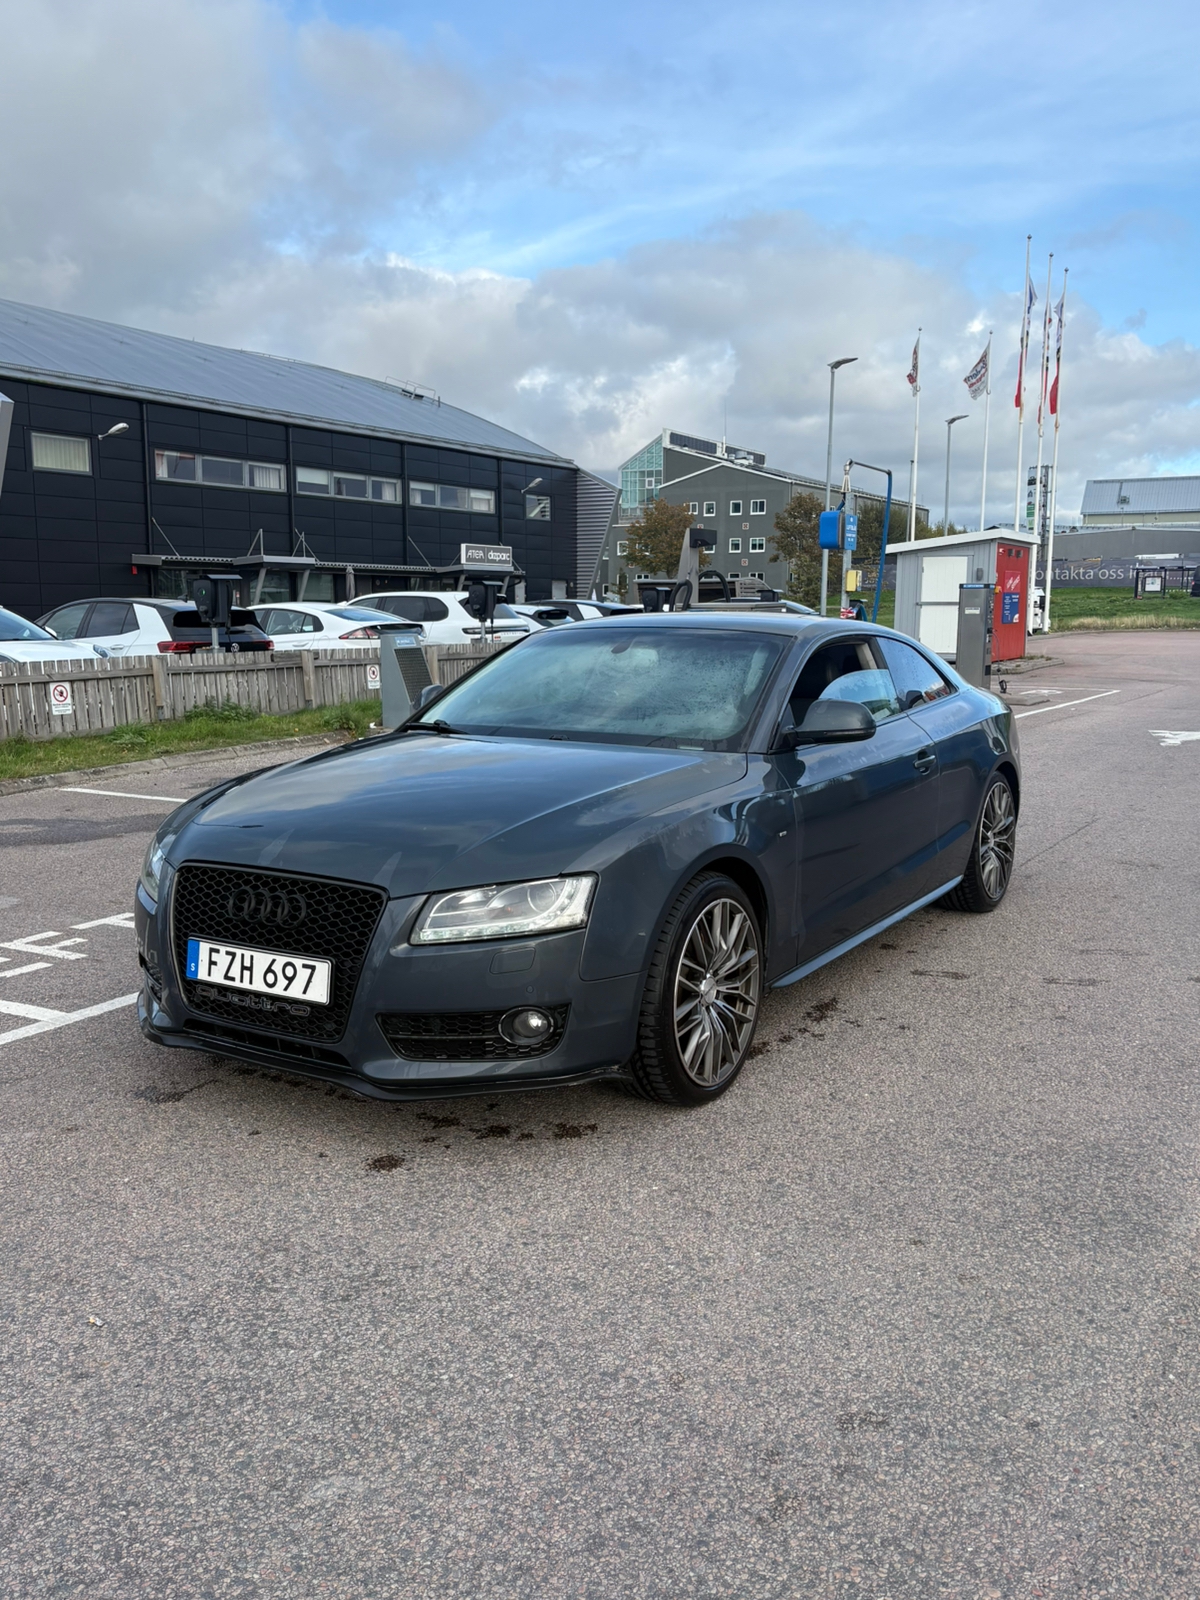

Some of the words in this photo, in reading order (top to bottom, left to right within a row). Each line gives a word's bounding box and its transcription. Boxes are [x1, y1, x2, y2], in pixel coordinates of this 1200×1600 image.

[466, 549, 485, 560] ATEA
[1034, 566, 1094, 581] ontakta
[1098, 567, 1125, 580] oss
[190, 962, 196, 972] S
[207, 946, 254, 985] FZH
[262, 958, 317, 995] 697
